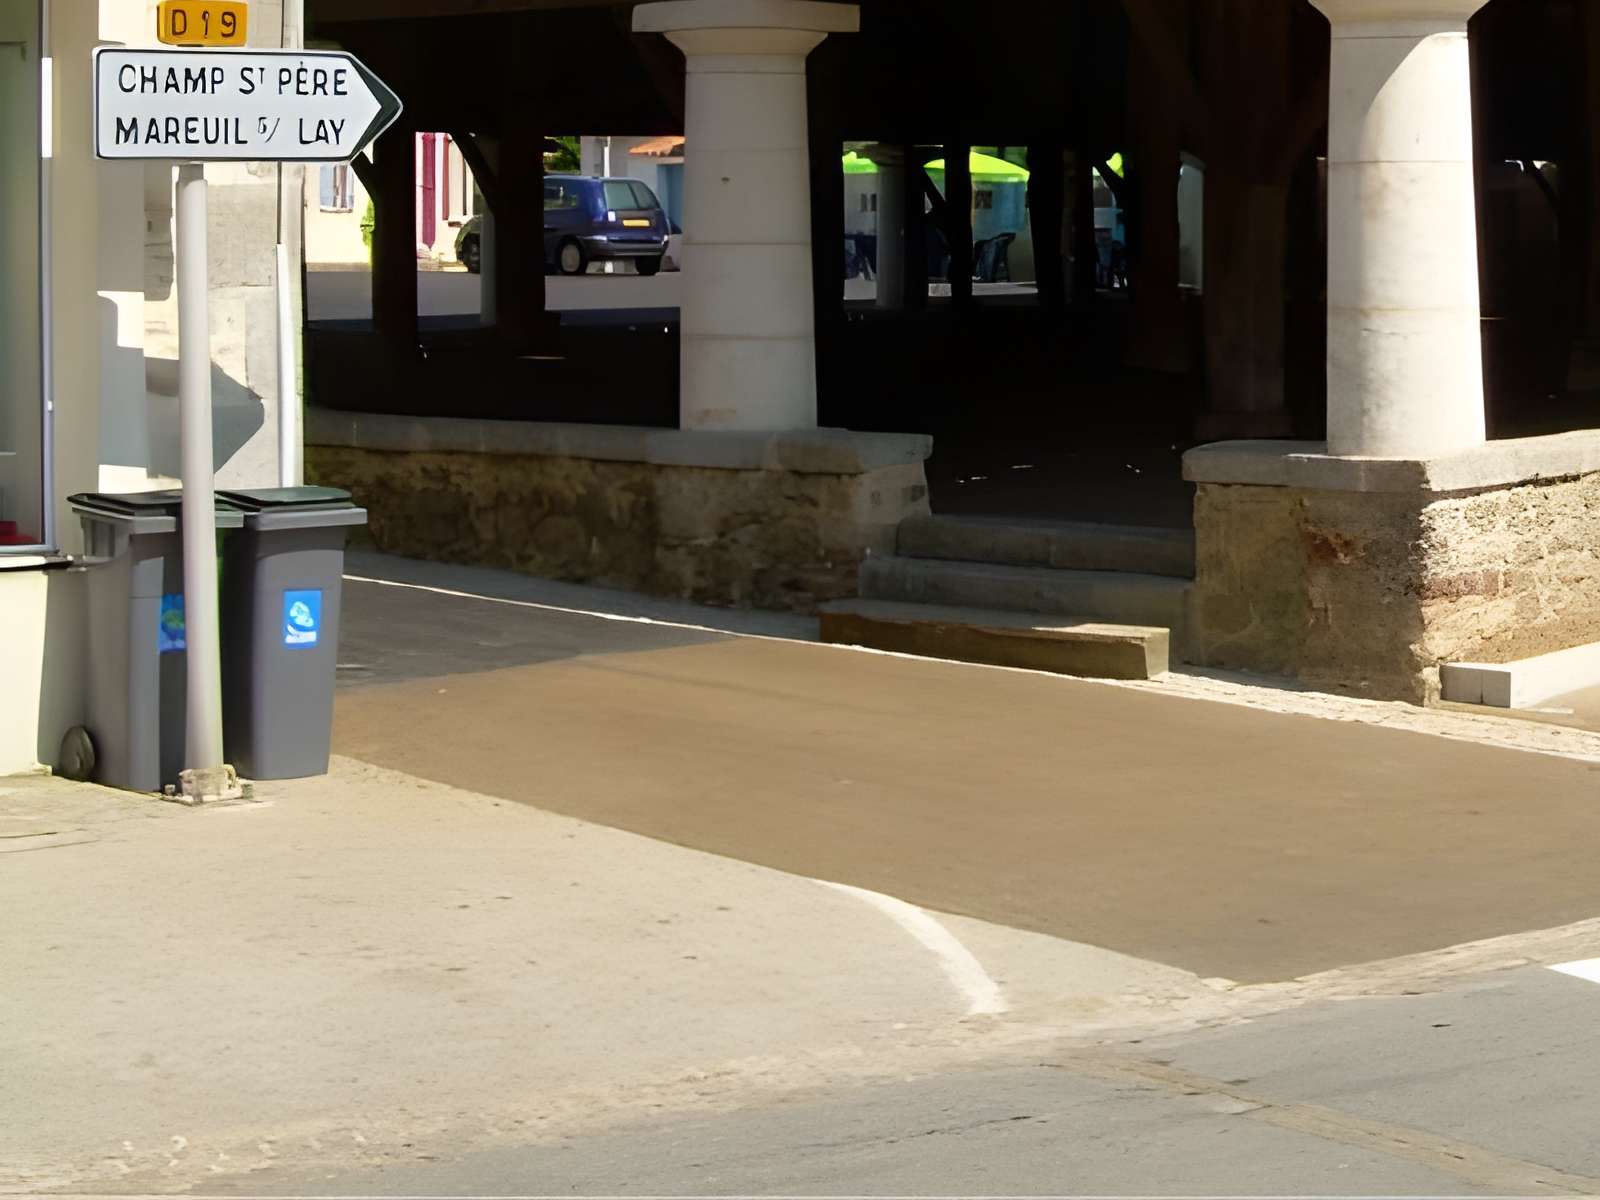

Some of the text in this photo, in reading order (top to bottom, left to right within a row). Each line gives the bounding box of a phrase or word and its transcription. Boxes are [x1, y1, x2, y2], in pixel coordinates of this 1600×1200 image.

[118, 63, 225, 95] CHAMP
[115, 116, 248, 145] MAREUIL
[298, 117, 345, 145] LAY
